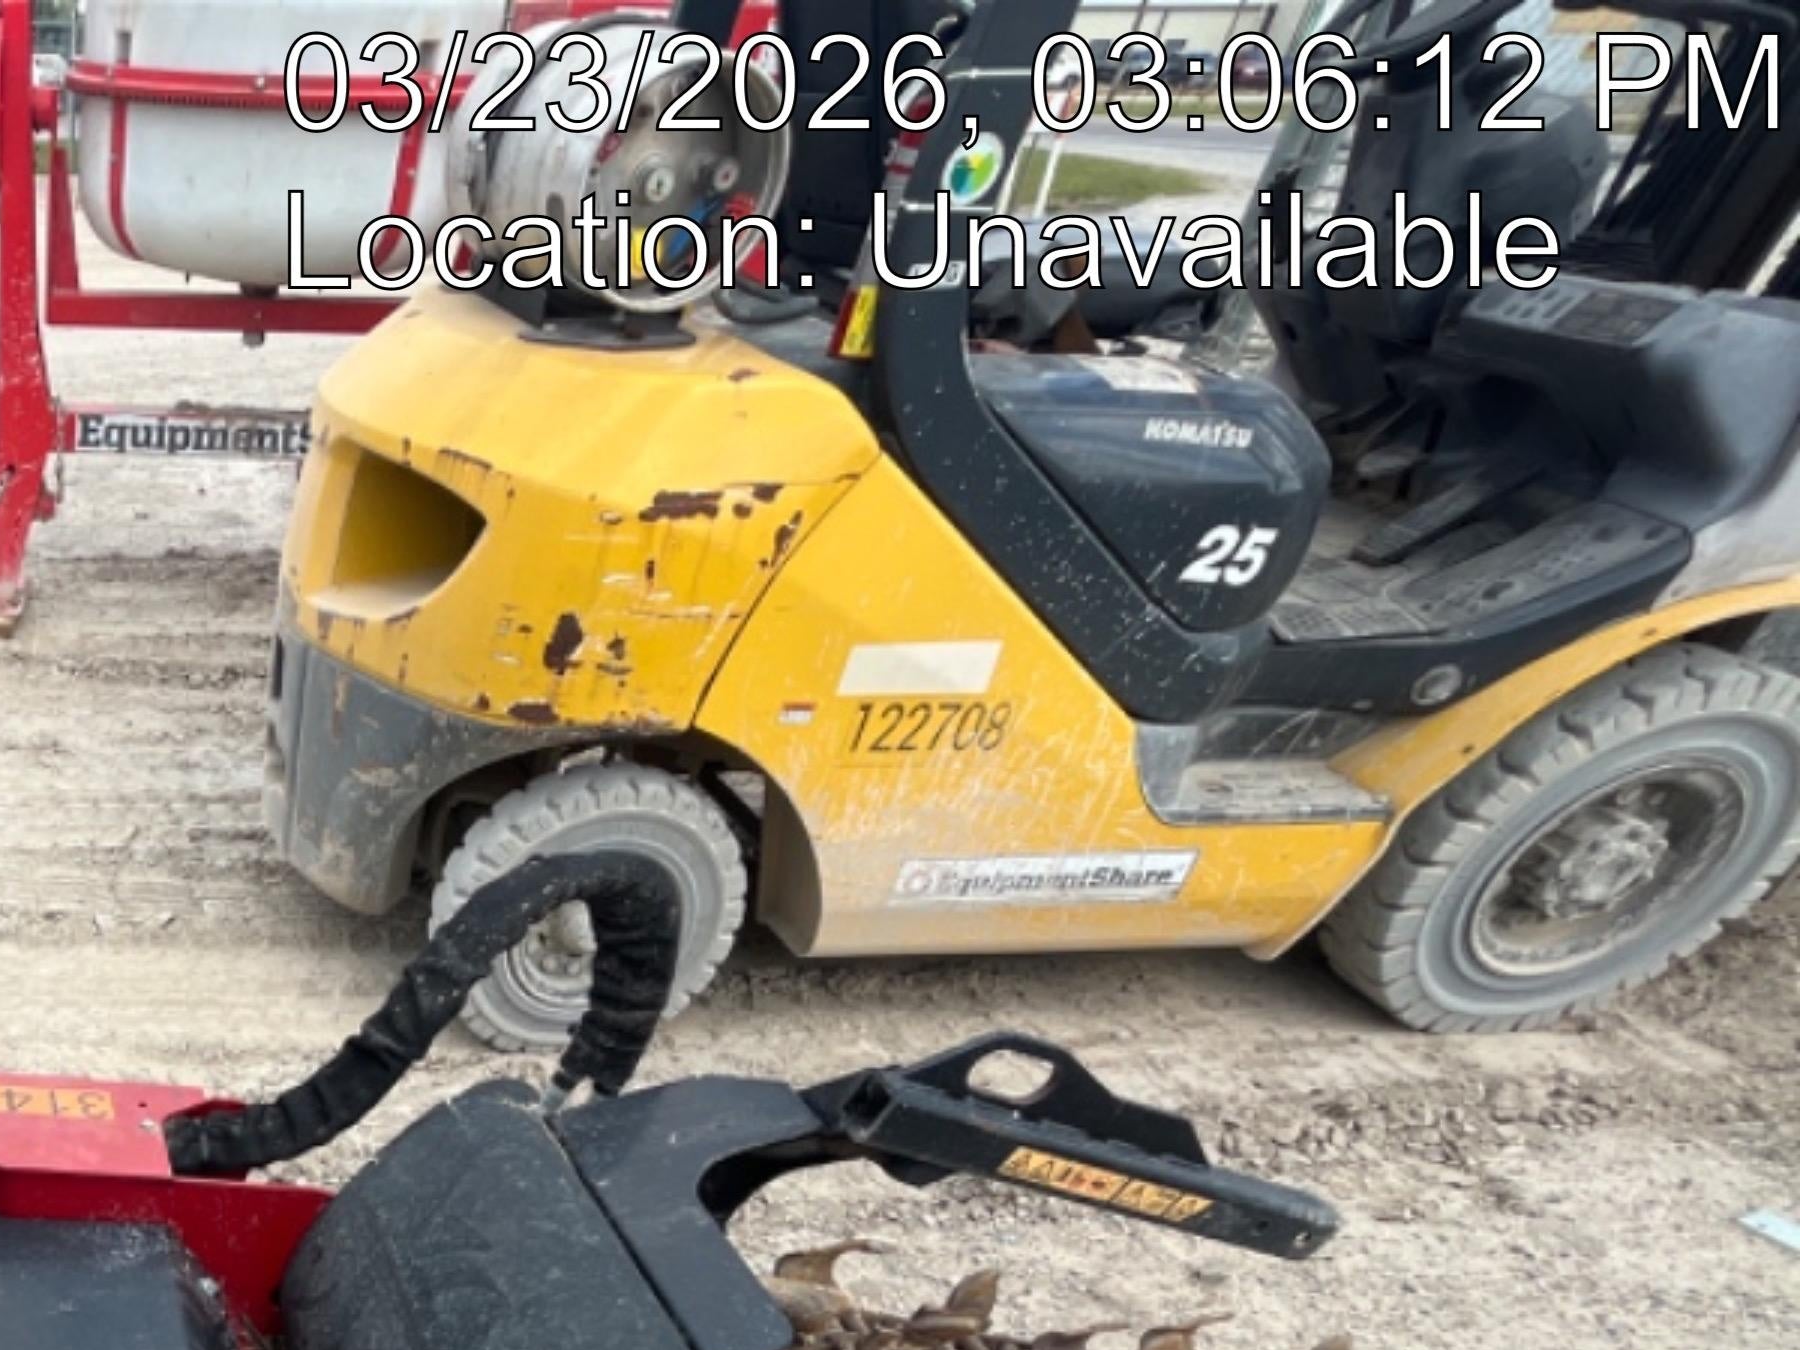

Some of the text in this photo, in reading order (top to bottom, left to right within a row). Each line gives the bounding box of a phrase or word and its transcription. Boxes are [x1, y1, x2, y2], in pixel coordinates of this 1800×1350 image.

[1144, 418, 1254, 448] KOMATSU
[1178, 524, 1279, 586] 25
[849, 702, 1012, 752] 122708
